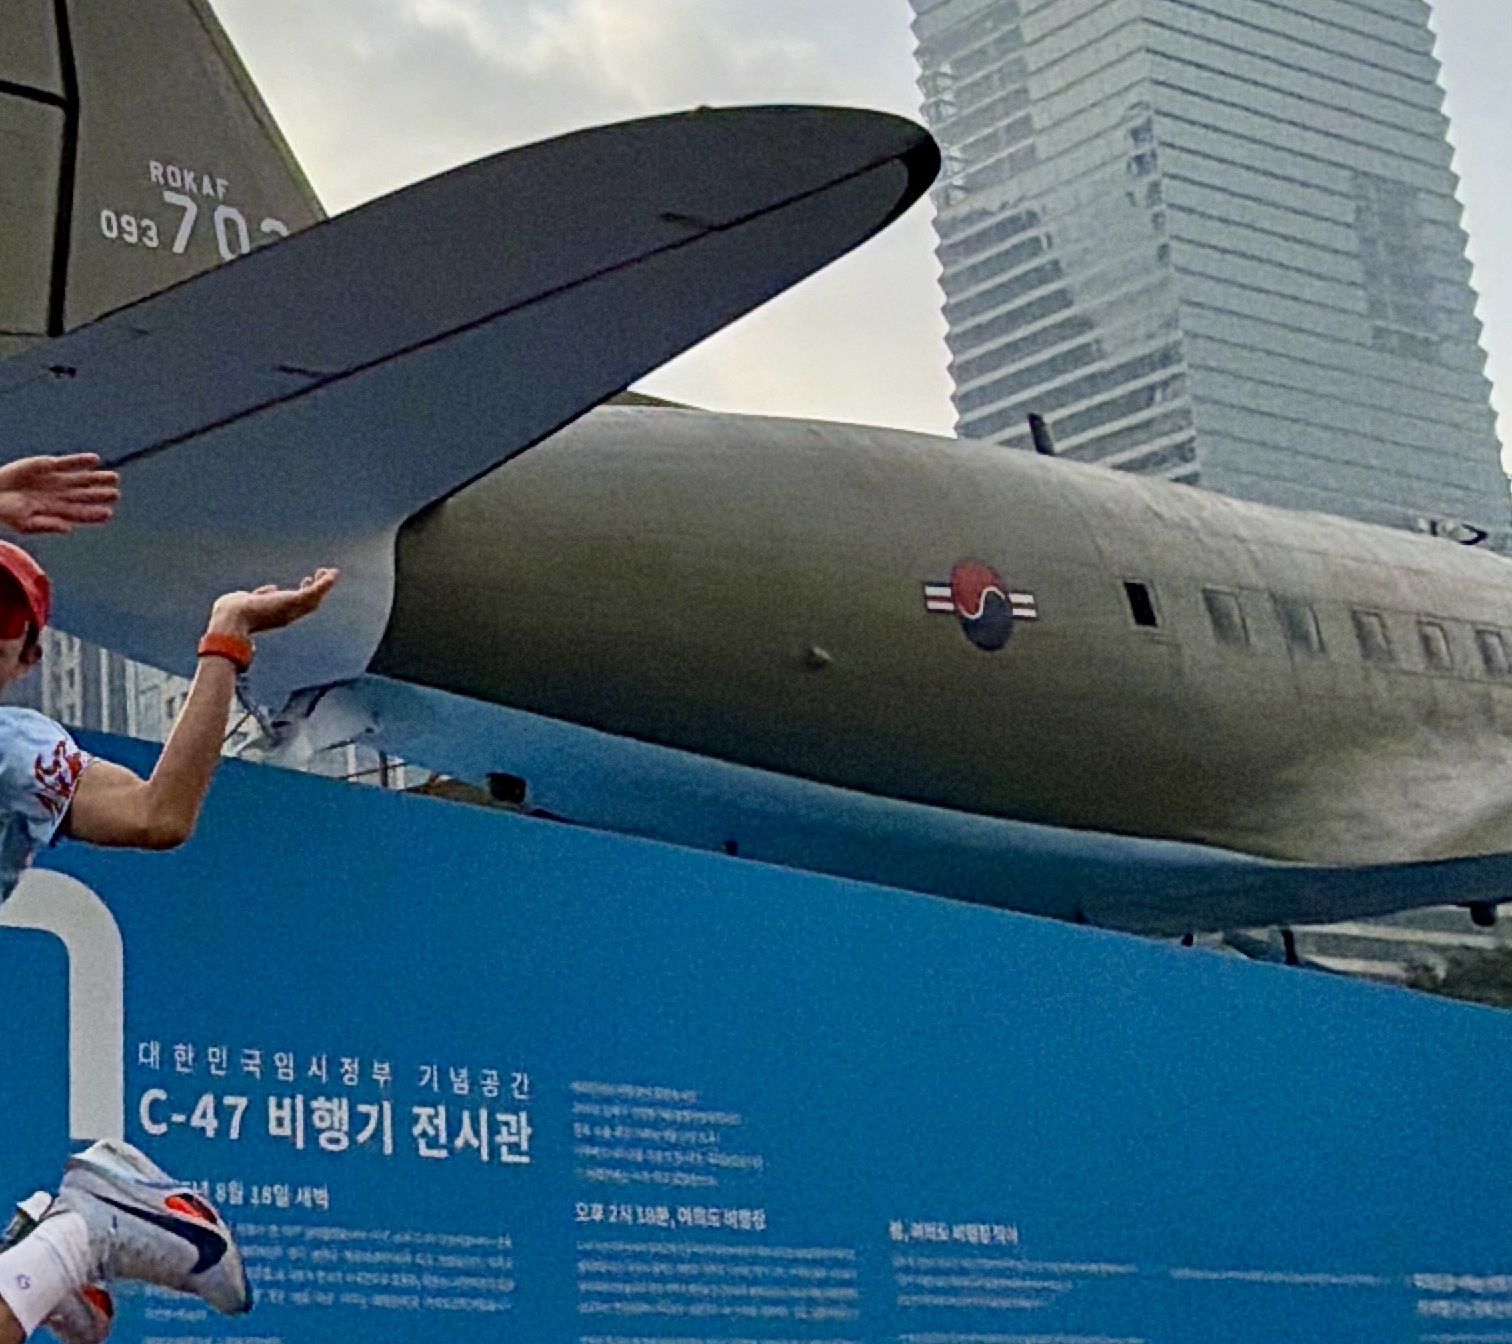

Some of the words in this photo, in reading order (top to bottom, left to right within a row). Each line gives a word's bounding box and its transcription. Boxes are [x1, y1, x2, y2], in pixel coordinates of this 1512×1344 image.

[149, 160, 229, 200] ROKAF
[100, 209, 159, 248] 093
[138, 1040, 392, 1089] 대한민국임시정부
[418, 1064, 532, 1100] 기념공간
[138, 1088, 248, 1140] C-47
[268, 1094, 394, 1156] 비행기
[411, 1104, 533, 1164] 전시관
[215, 1180, 244, 1205] 8월
[250, 1183, 290, 1208] 18일
